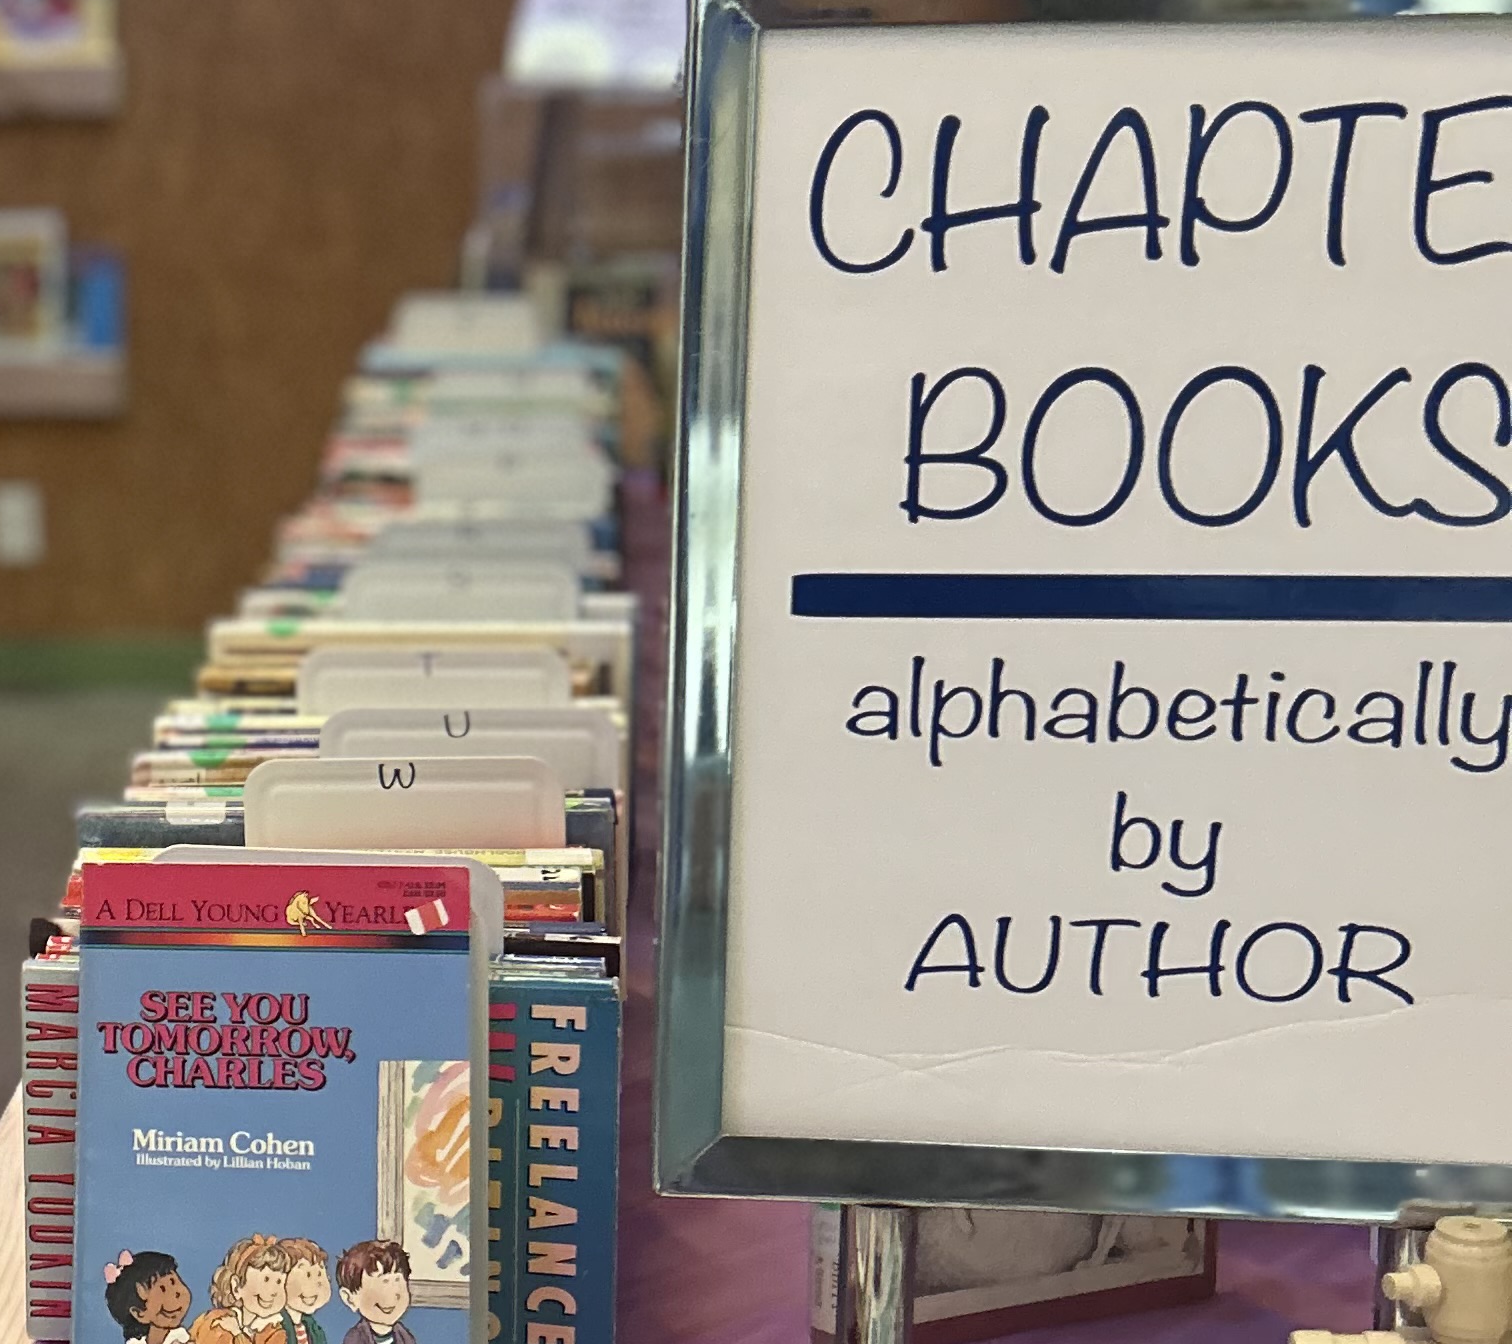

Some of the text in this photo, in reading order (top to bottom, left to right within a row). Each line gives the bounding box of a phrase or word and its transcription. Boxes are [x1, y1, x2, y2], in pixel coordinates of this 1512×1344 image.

[900, 362, 1512, 529] BOOKS
[443, 710, 471, 739] U
[846, 656, 1512, 773] alphabetically
[378, 762, 416, 790] W
[1111, 791, 1223, 898] by
[95, 898, 414, 926] A DELL YOUNG YEARL
[905, 913, 1415, 1005] AUTHOR
[139, 990, 310, 1026] SEE YOU
[96, 1021, 357, 1065] TOMORROW,
[24, 982, 80, 1146] MARCIA
[126, 1055, 327, 1091] CHARLES
[132, 1128, 315, 1156] Miriam Cohen
[136, 1152, 311, 1171] Illustrated by Lillian Hoban
